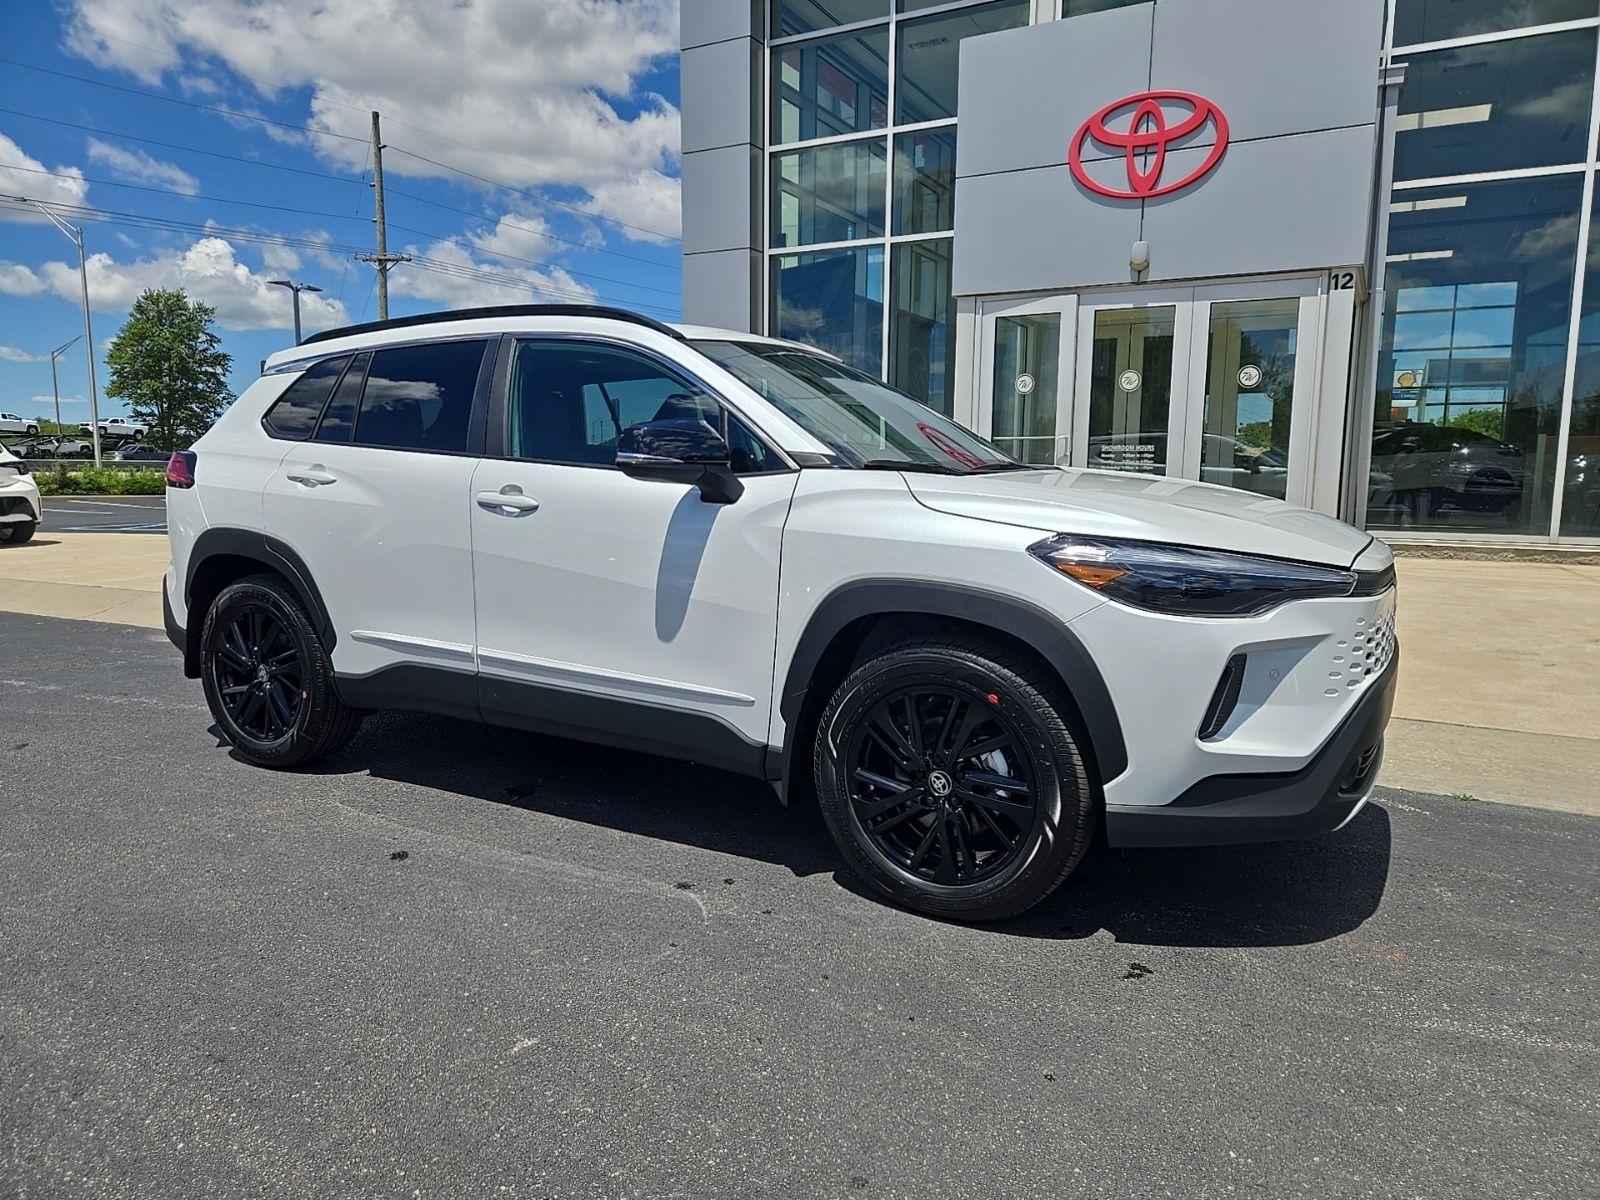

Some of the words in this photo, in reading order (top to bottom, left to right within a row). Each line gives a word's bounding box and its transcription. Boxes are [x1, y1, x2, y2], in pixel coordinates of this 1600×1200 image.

[1332, 272, 1354, 290] 12
[1101, 444, 1135, 452] SHOWROOM
[1135, 444, 1155, 452] HOURS
